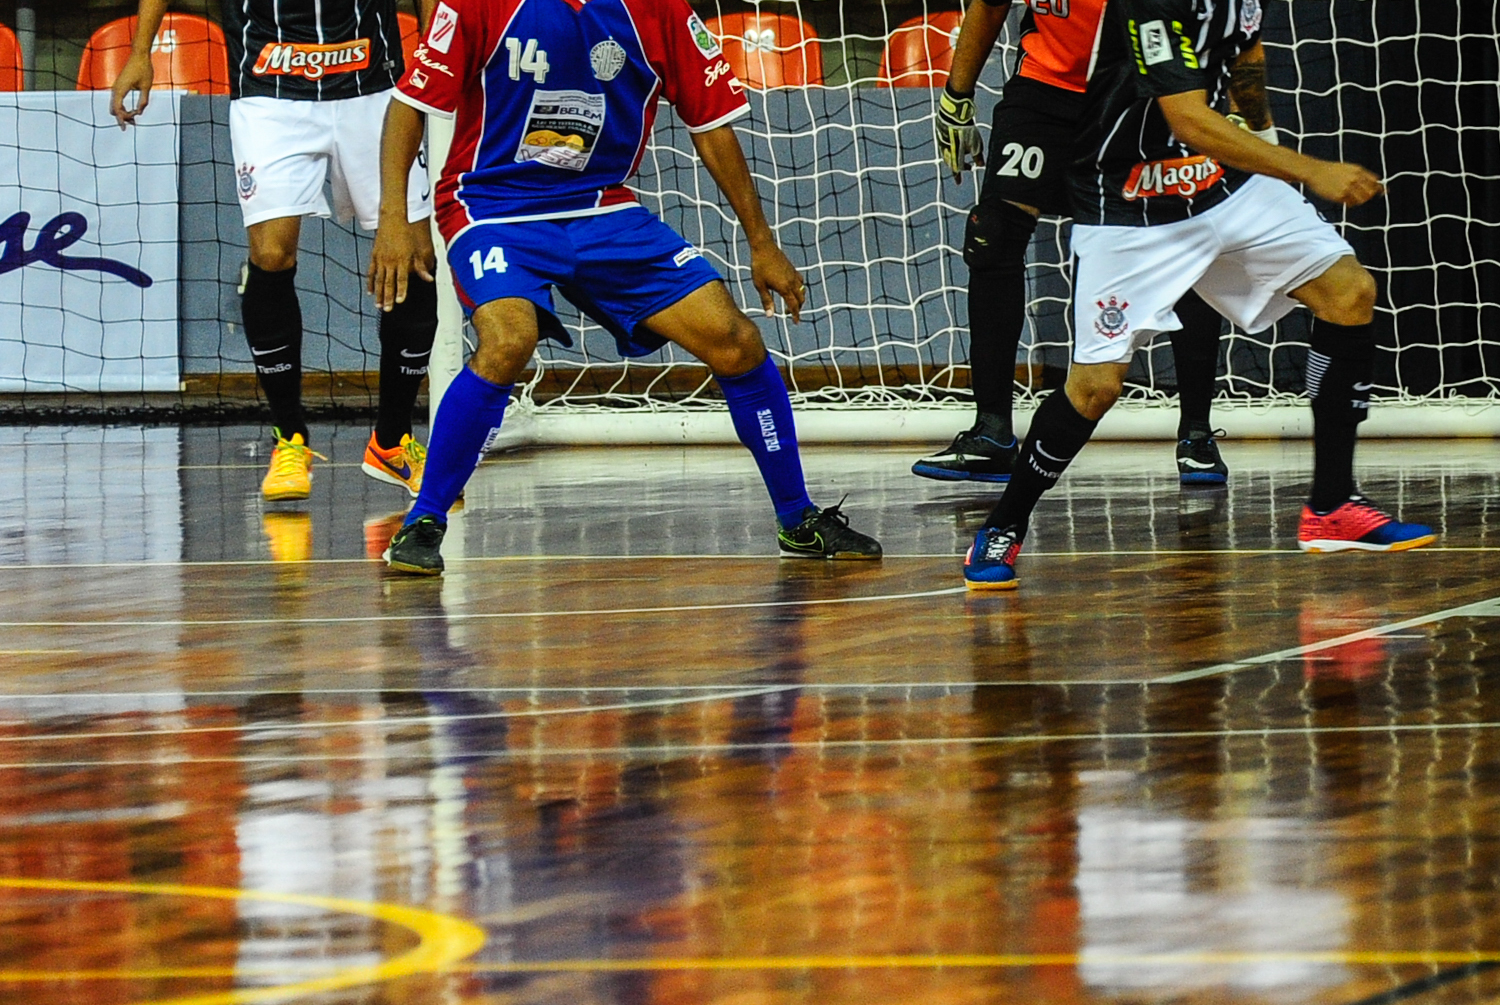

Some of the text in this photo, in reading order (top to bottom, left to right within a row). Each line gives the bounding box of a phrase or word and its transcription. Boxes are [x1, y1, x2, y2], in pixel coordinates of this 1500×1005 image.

[255, 43, 366, 79] Magnus
[505, 37, 550, 83] 14
[559, 107, 602, 121] BELÉM
[996, 142, 1044, 180] 20
[469, 246, 508, 280] 14
[257, 362, 292, 374] Timão
[399, 365, 429, 375] Timã
